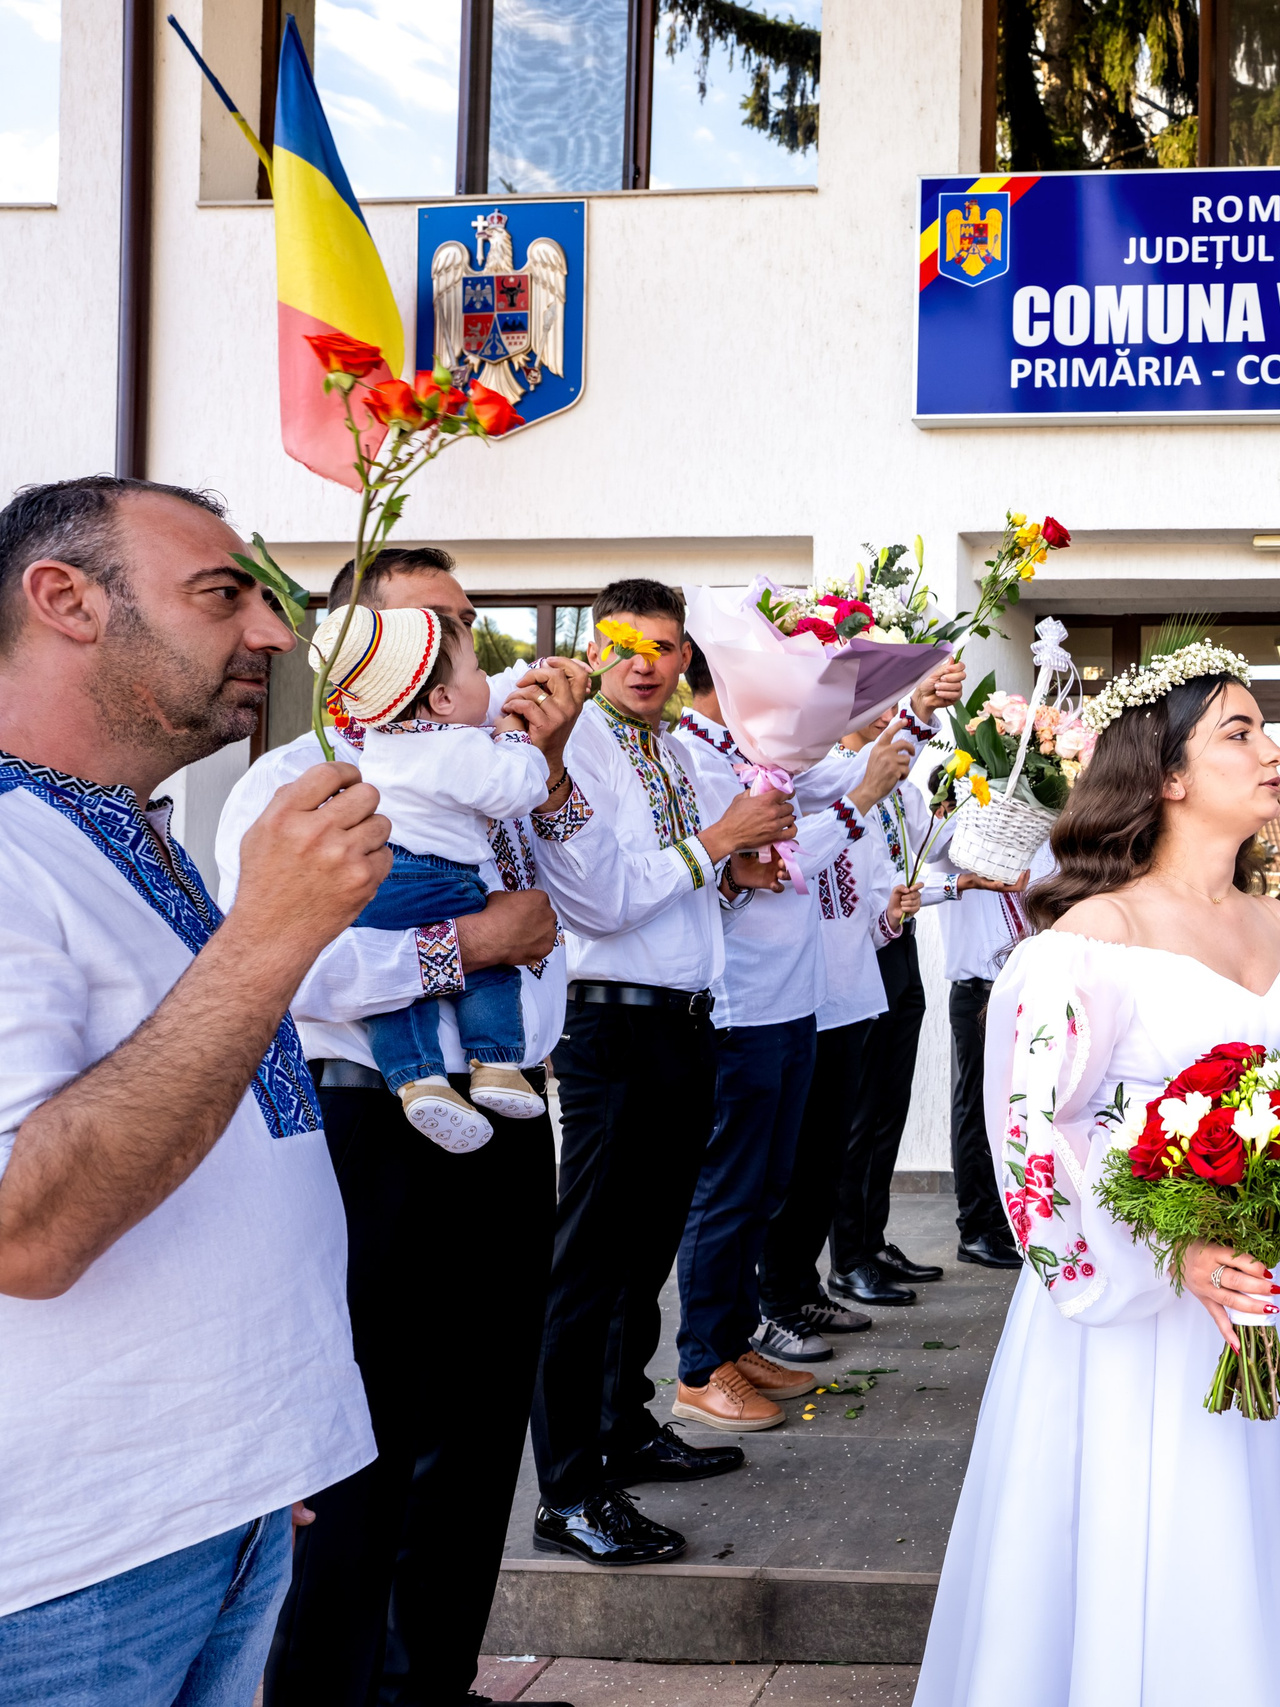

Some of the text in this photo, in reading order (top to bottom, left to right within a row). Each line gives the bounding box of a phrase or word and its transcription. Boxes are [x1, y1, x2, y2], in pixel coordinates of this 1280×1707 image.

[1123, 234, 1275, 270] JUDEȚUL
[1012, 282, 1266, 347] COMUNA
[1010, 348, 1202, 389] PRIMĂRIA
